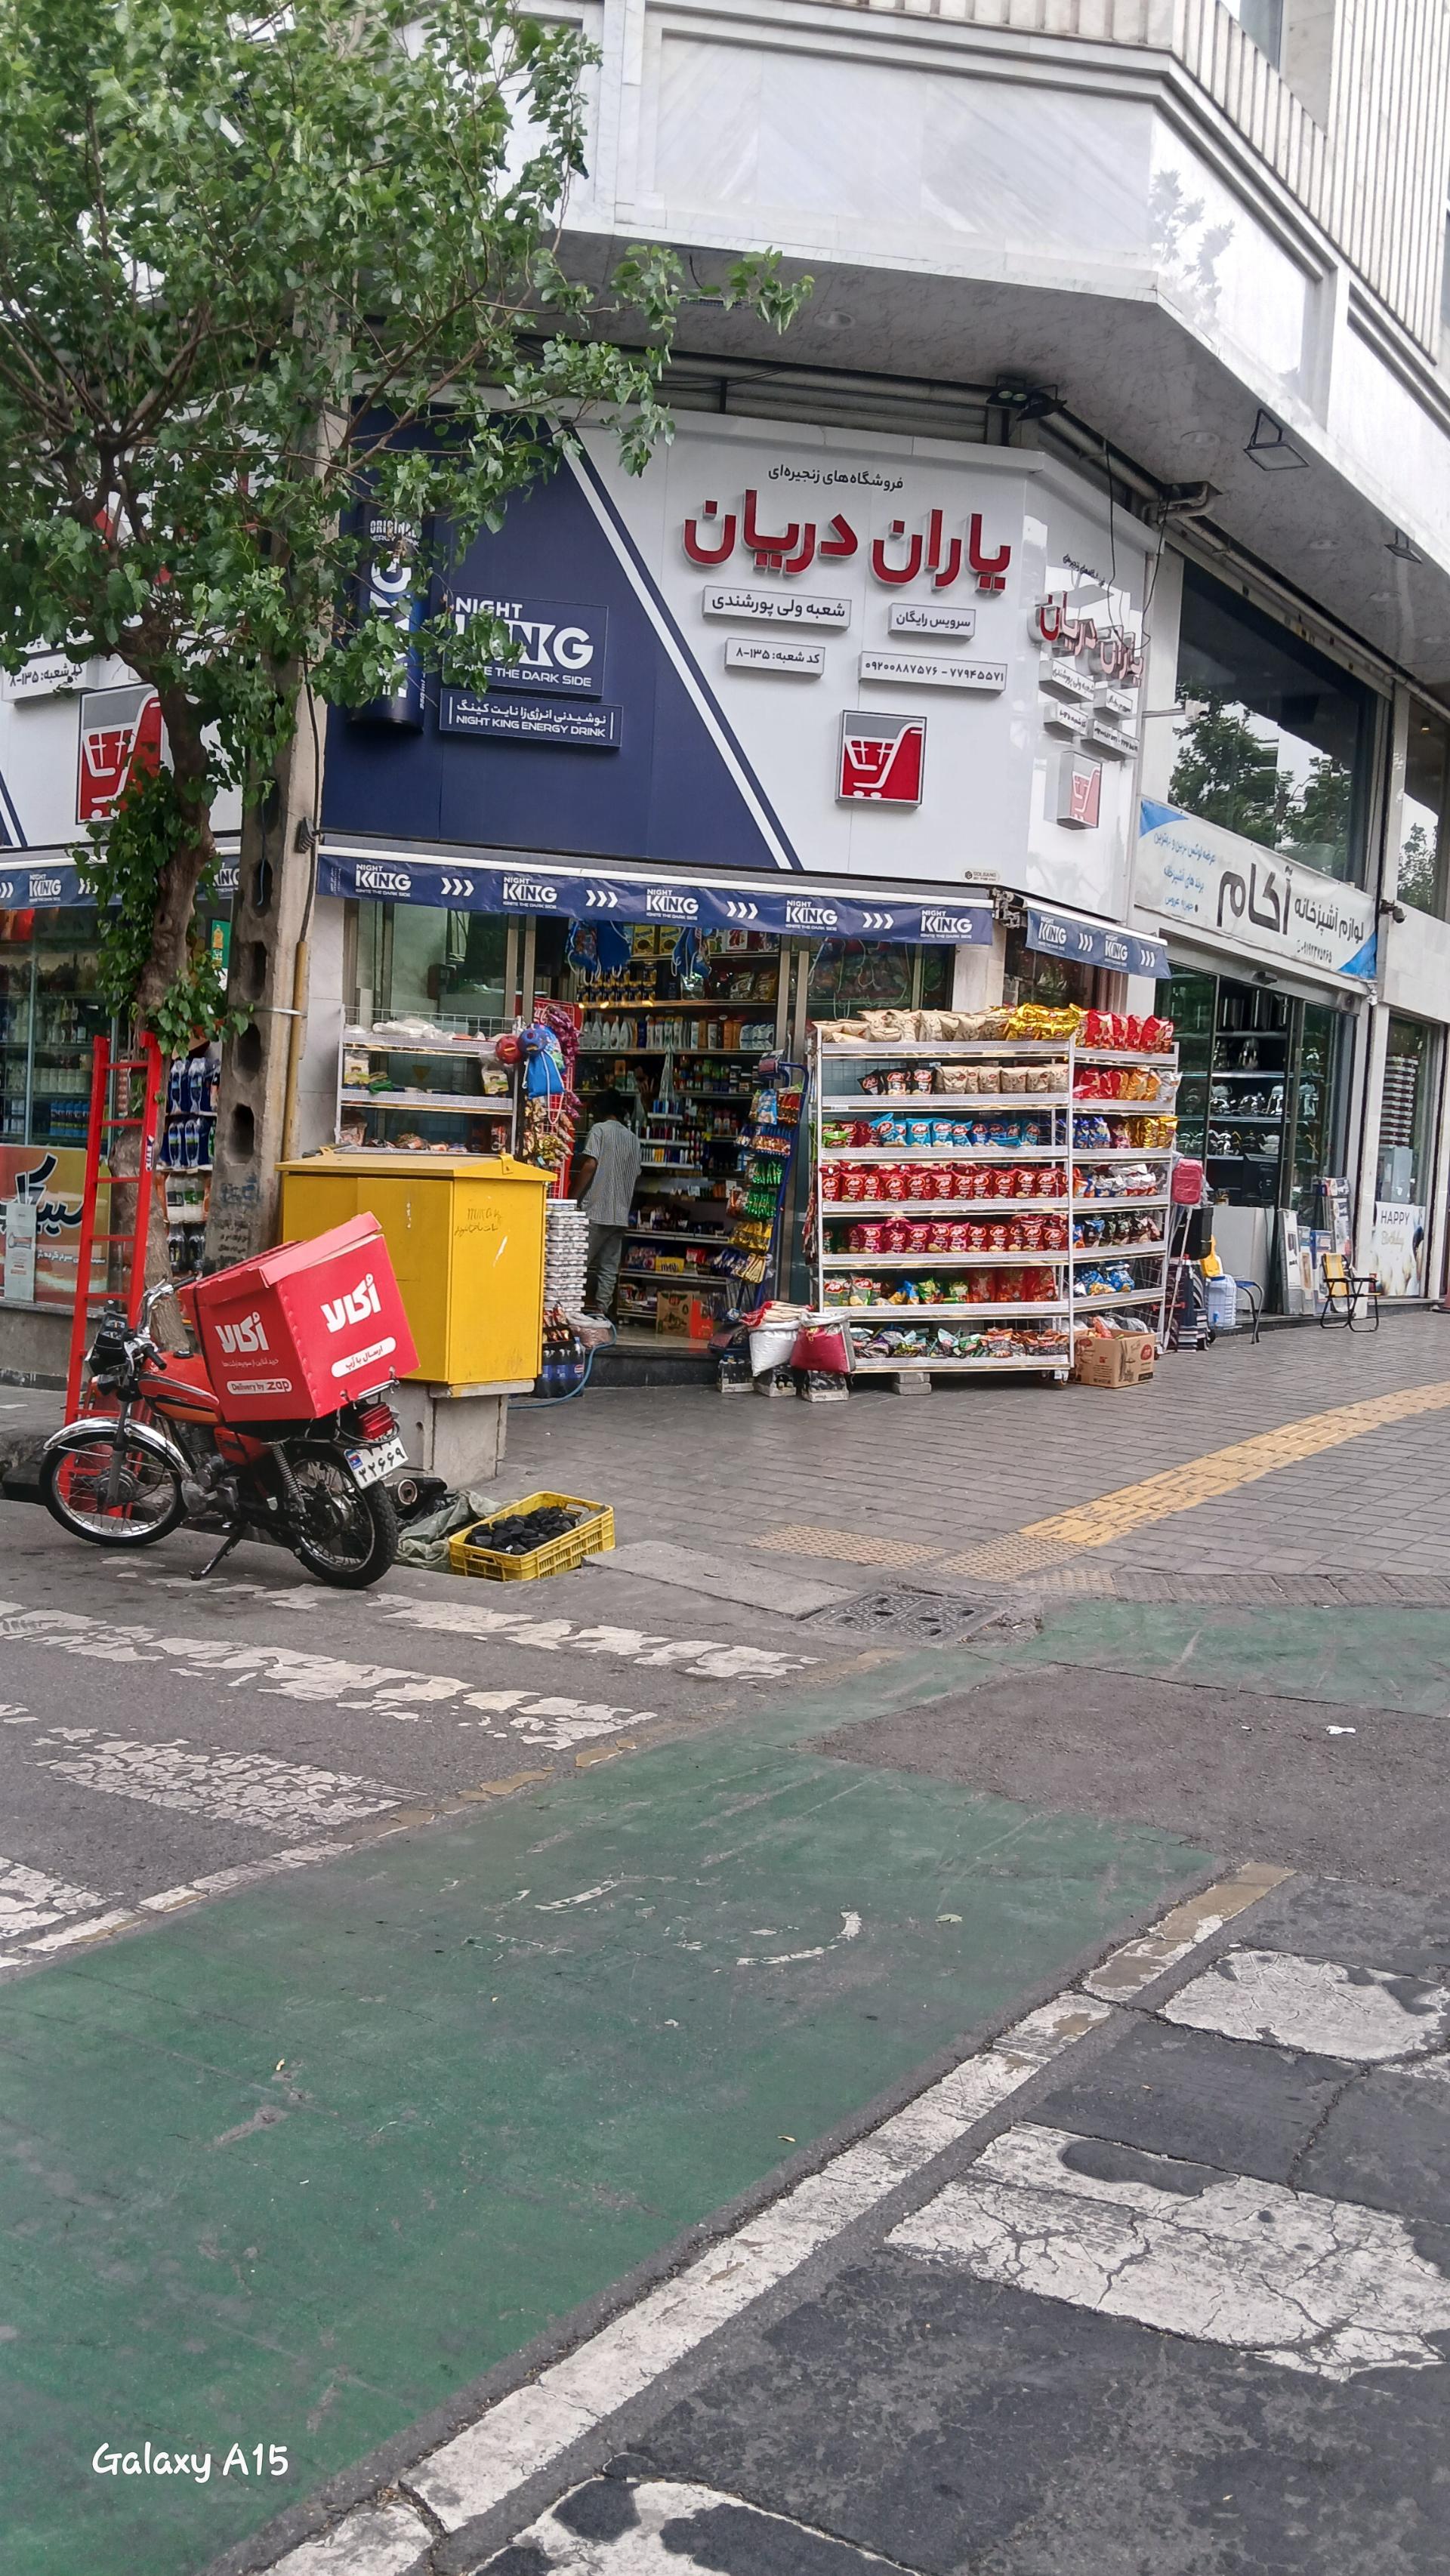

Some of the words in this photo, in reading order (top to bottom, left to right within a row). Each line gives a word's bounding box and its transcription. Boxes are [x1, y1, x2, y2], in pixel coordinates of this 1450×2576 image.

[683, 488, 859, 575] دریان
[871, 508, 1012, 592] یاران
[455, 596, 523, 618] NIGHT
[712, 594, 774, 617] پورشندی
[777, 599, 803, 617] ولی
[807, 603, 845, 619] شعبه
[896, 610, 928, 627] رایگان
[930, 617, 970, 629] سرویس
[807, 653, 819, 664] کد
[495, 667, 520, 679] THE
[522, 670, 560, 684] DARK
[562, 675, 592, 687] SIDE
[456, 699, 489, 715] کینگ
[491, 704, 519, 716] نایت
[456, 715, 490, 726] NIGHT
[492, 718, 520, 729] KING
[521, 722, 569, 733] ENERGY
[570, 726, 606, 737] DRINK
[554, 711, 606, 726] نوشیدنی
[29, 879, 61, 897] KING
[356, 870, 412, 891] KING
[503, 883, 557, 903] KING
[1217, 863, 1294, 935] آکام
[646, 895, 699, 914] KING
[785, 906, 838, 926] KING
[921, 916, 973, 934] KING
[1294, 898, 1338, 936] آشپزخانه
[1038, 922, 1066, 944] KING
[1338, 917, 1363, 944] لوازم
[1105, 940, 1128, 961] KING
[1381, 1209, 1410, 1225] HAPPY
[363, 1345, 383, 1362] ارسال
[231, 1383, 255, 1392] Delivery
[256, 1382, 264, 1391] by
